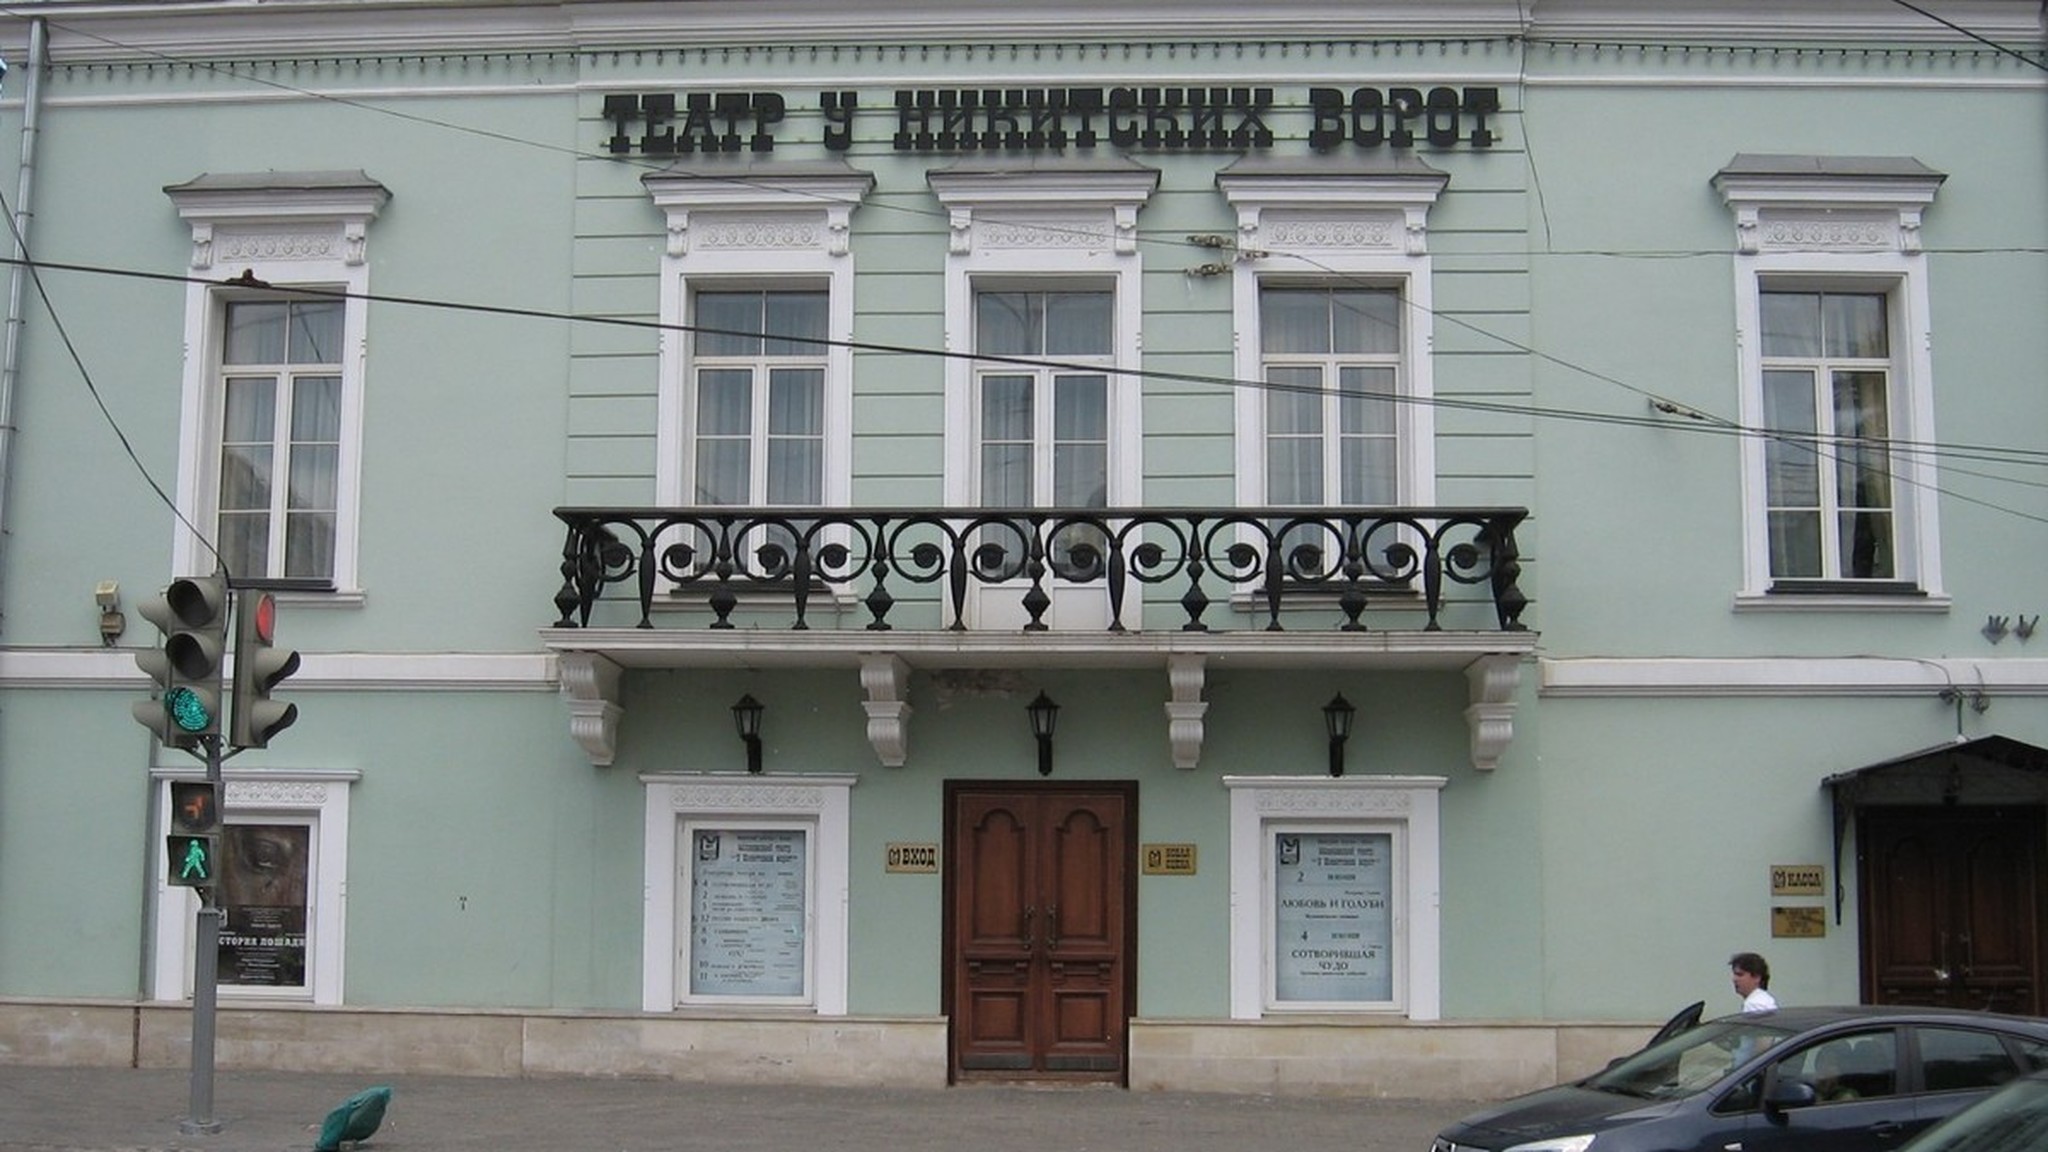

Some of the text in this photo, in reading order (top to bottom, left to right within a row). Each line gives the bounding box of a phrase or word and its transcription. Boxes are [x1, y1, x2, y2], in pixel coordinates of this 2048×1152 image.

[603, 87, 1498, 153] ТЕАТР У НИКИТСКИХ ВОРОТ
[902, 848, 936, 867] ВХОД
[1281, 899, 1384, 909] ЛЮБОВЬ И ГОЛУБИ
[219, 936, 257, 946] СТОРИЯ
[1291, 949, 1376, 959] СОТВОРИВШАЯ
[1318, 961, 1349, 971] ЧУДО
